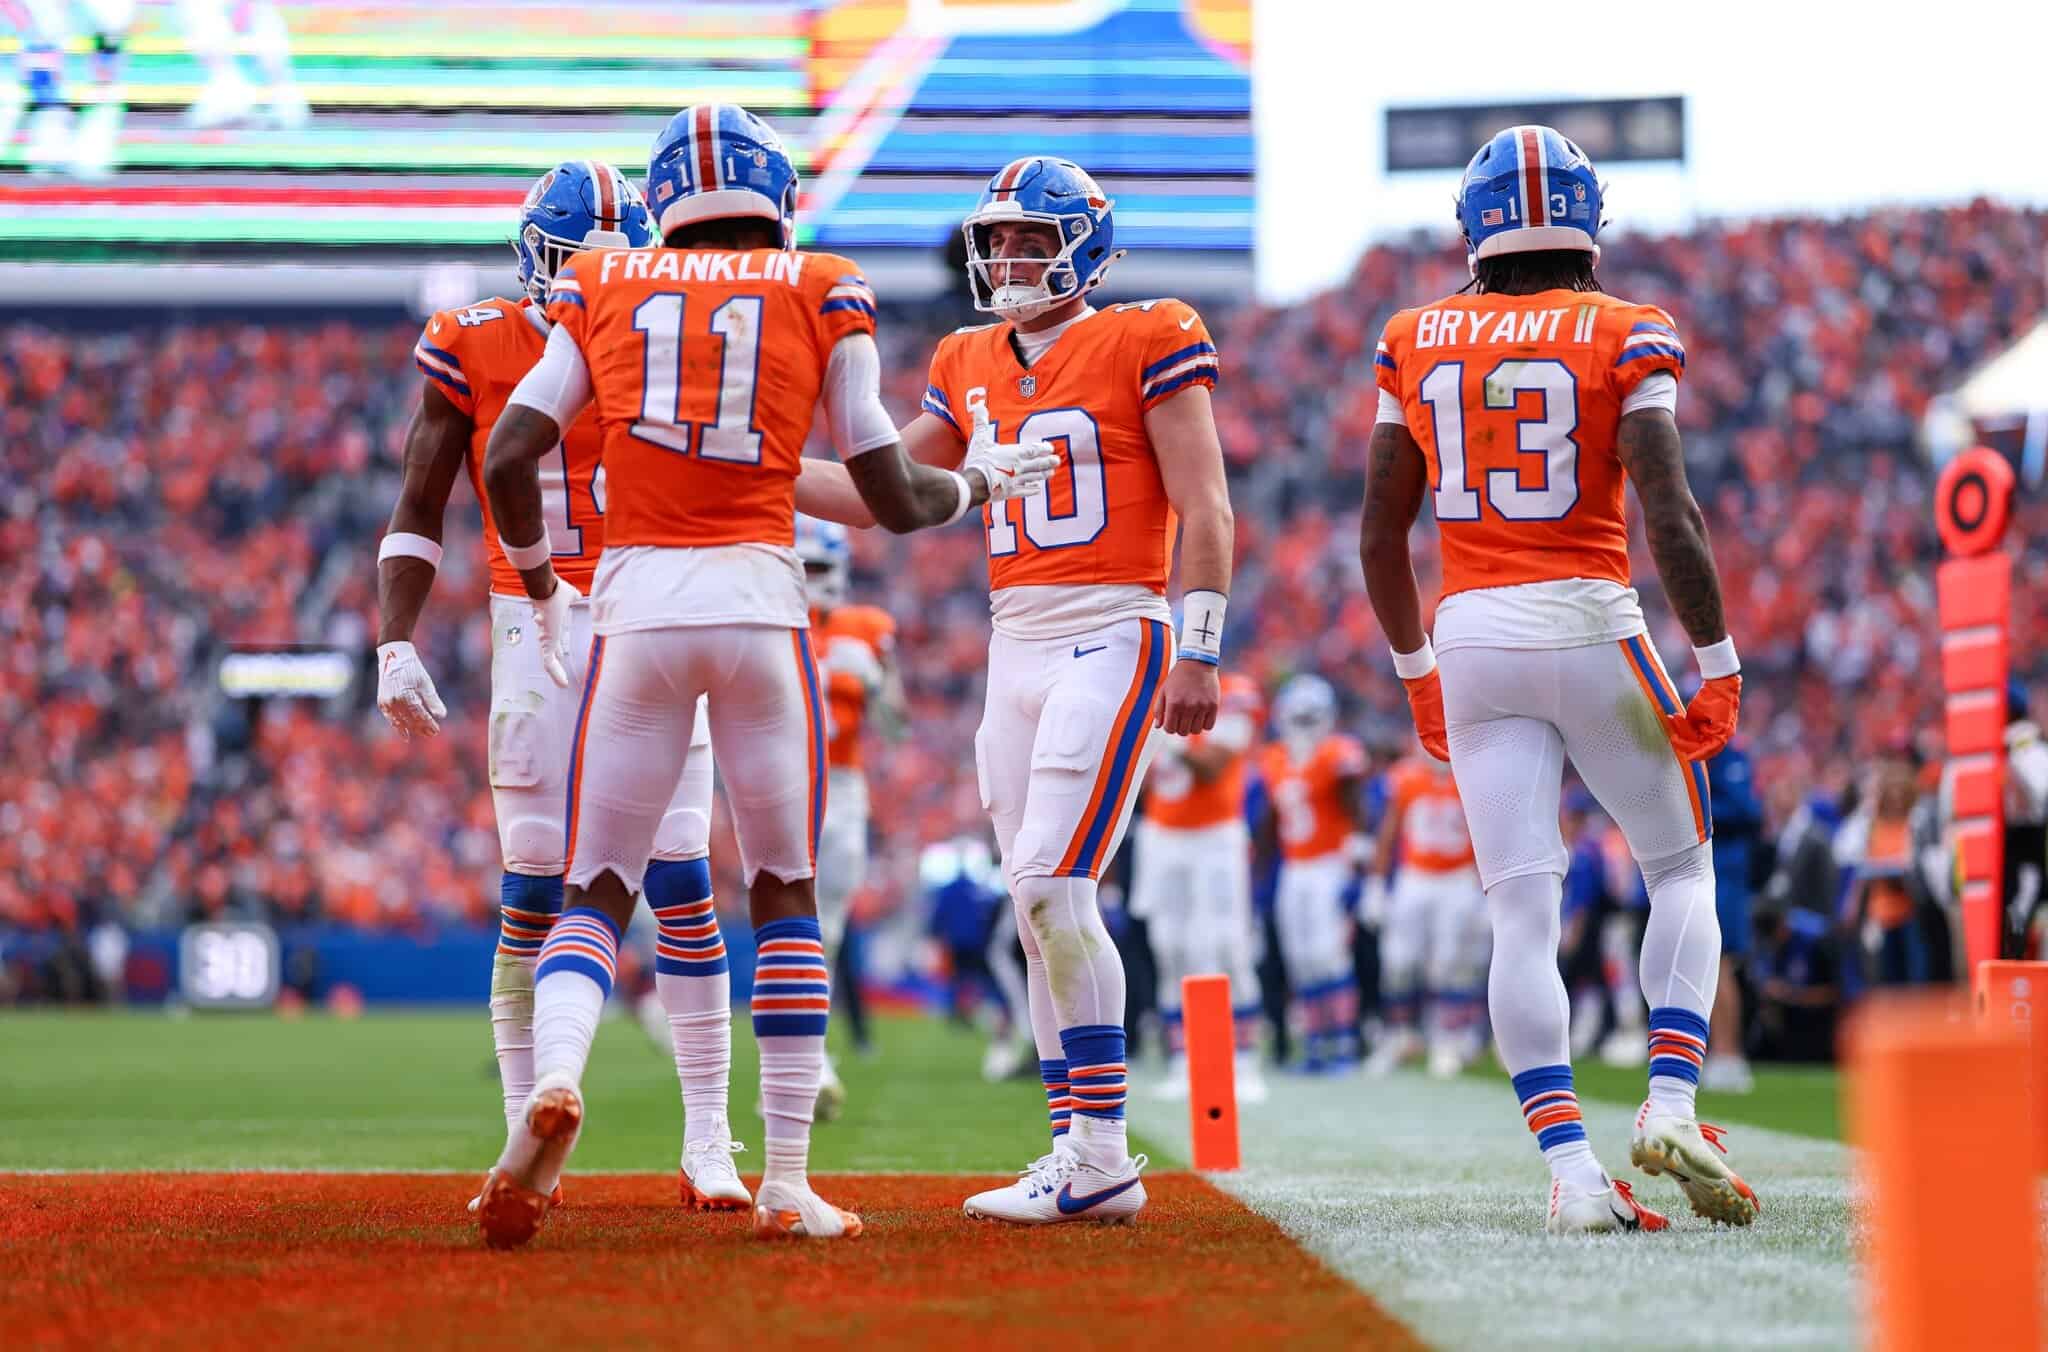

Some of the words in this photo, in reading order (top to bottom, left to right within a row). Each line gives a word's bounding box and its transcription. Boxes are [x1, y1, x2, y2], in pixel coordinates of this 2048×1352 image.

[1508, 196, 1518, 220] 1
[1550, 193, 1567, 218] 3
[600, 251, 805, 288] FRANKLIN
[1415, 306, 1571, 349] BRYANT
[1573, 303, 1599, 344] II
[628, 292, 766, 466] 11
[1420, 358, 1580, 522] 13
[537, 440, 606, 556] 1
